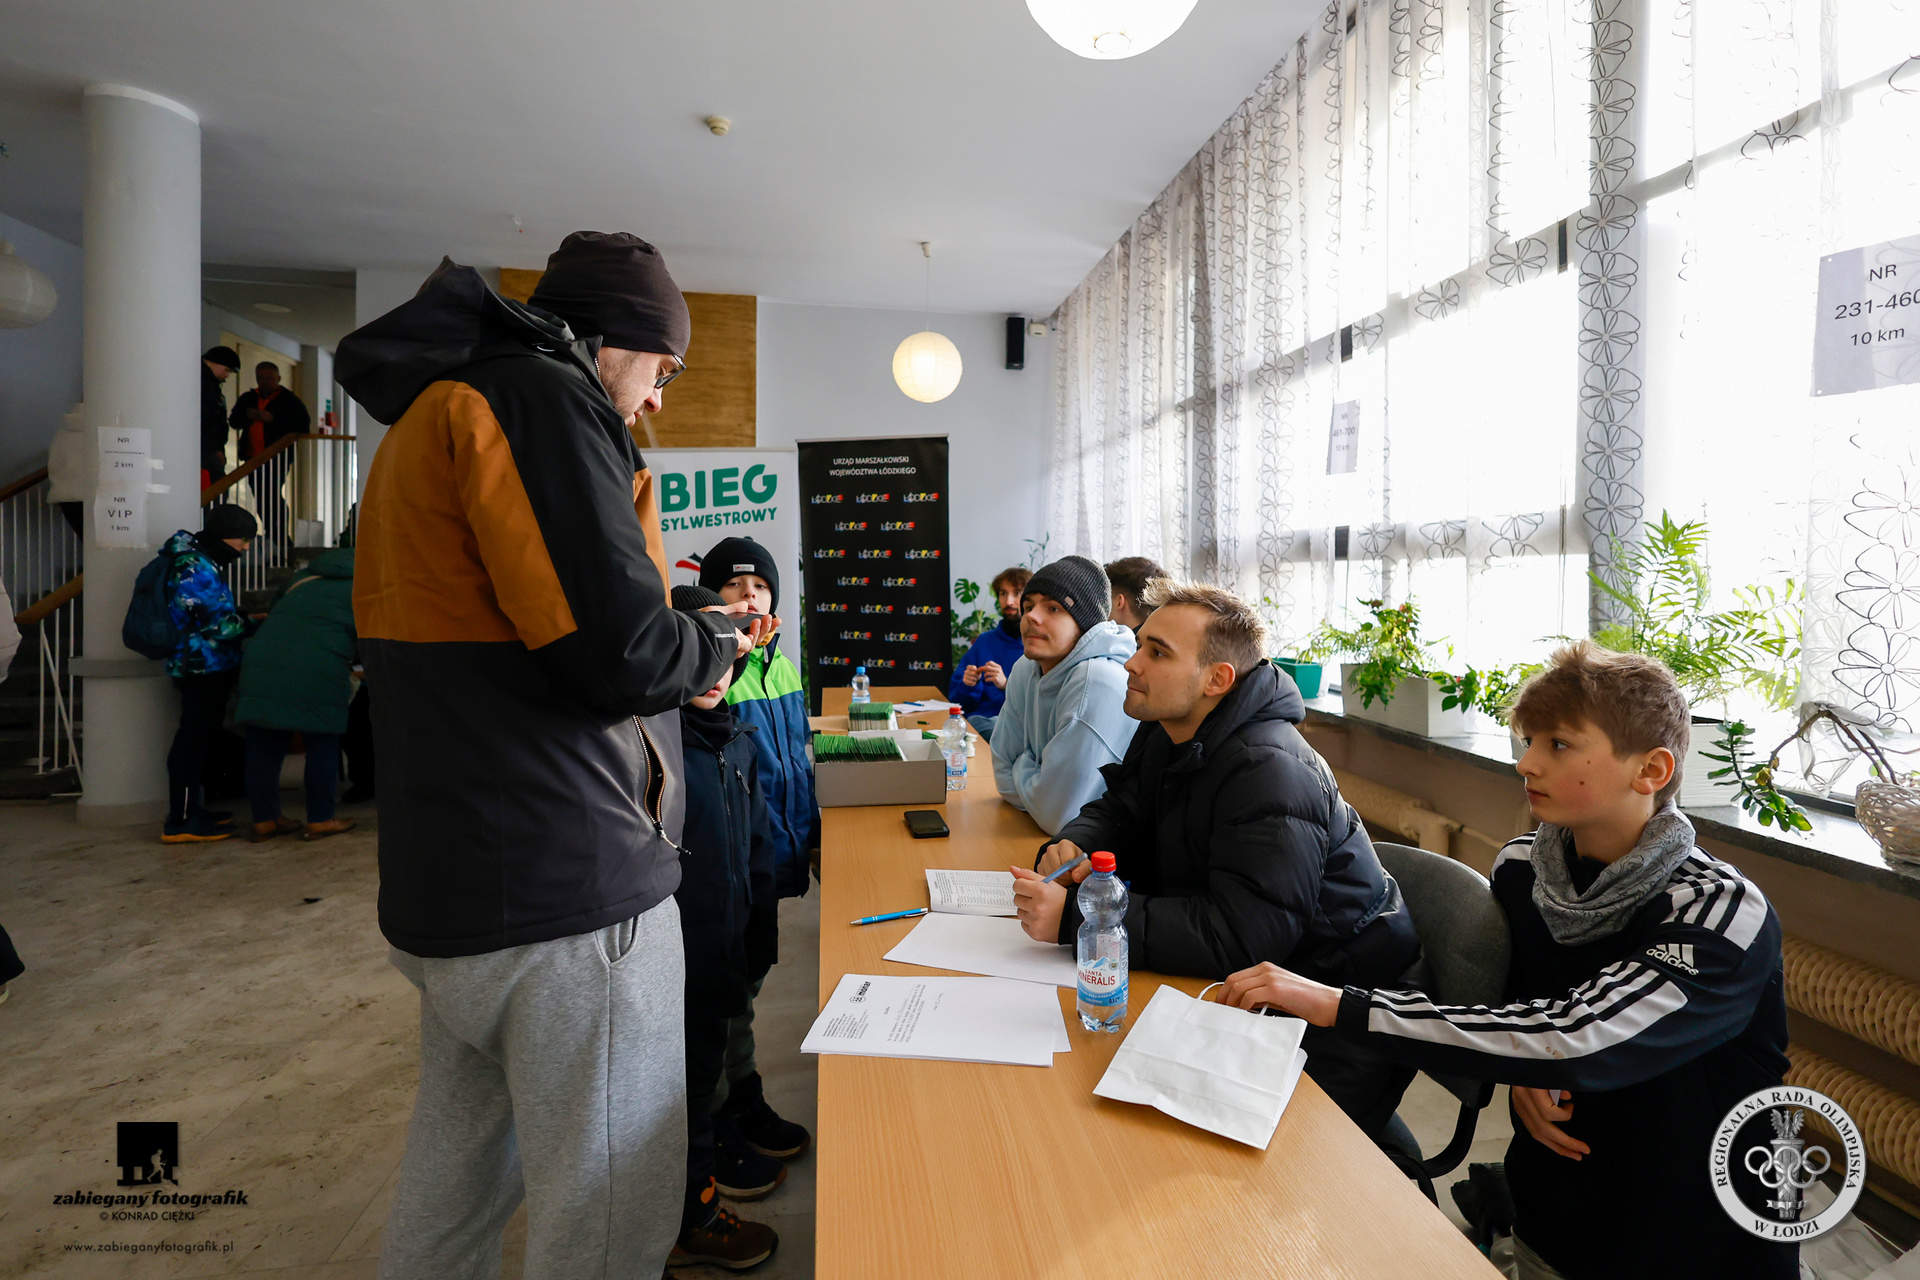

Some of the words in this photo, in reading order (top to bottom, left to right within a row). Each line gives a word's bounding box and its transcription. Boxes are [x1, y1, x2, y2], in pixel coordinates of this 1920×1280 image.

[1869, 264, 1897, 281] NR
[1834, 288, 1920, 319] 231-460
[1850, 332, 1872, 345] 10
[1878, 328, 1905, 342] km
[855, 456, 909, 464] MARSZAŁKOWSKI
[829, 468, 878, 476] WOJEWÓDZTWA
[879, 466, 917, 475] ŁÓDZKIEGO
[661, 464, 778, 512] BIEG
[108, 510, 132, 518] VIP
[660, 507, 777, 532] SYLWESTROWY
[1646, 948, 1699, 976] adidas
